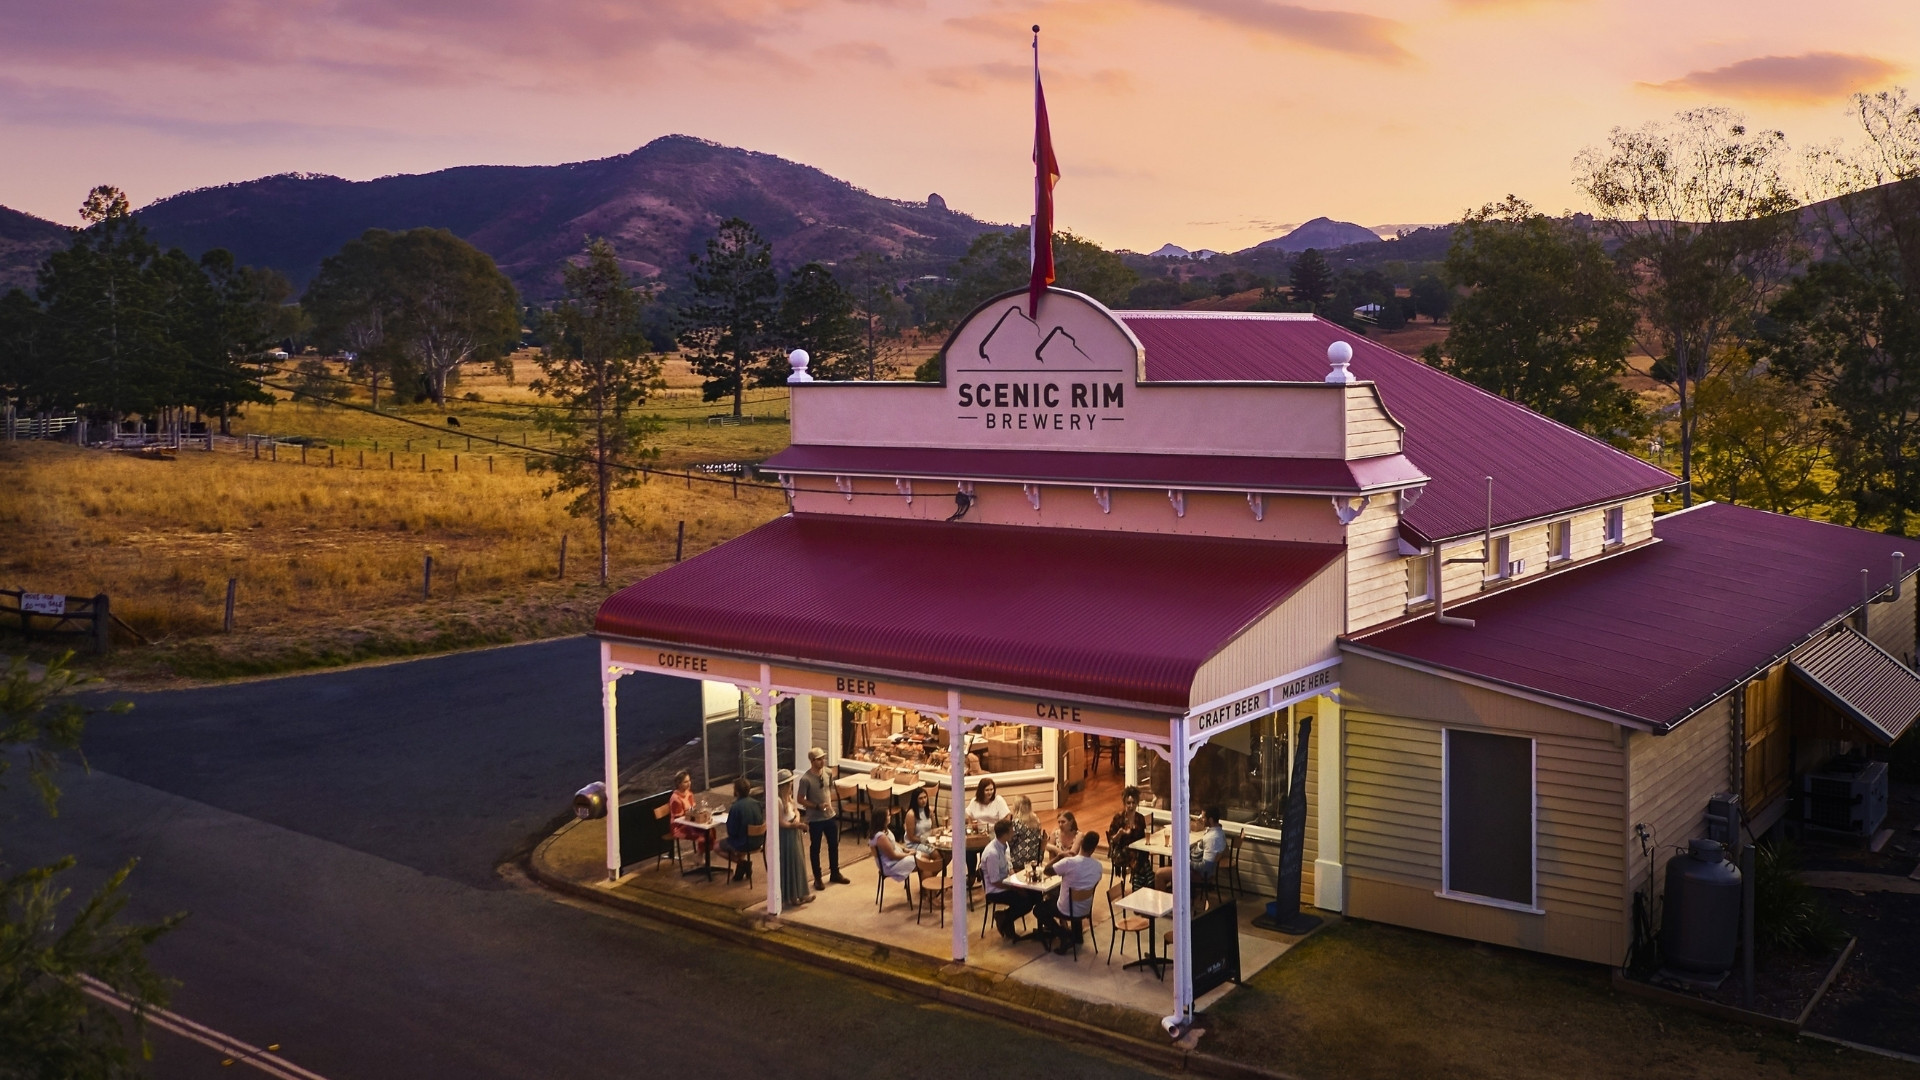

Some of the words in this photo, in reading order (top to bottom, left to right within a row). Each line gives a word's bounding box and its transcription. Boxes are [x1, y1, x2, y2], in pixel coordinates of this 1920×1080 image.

[958, 383, 1060, 408] SCENIC
[1071, 383, 1124, 408] RIM
[986, 413, 1097, 430] BREWERY
[658, 652, 708, 672] COFFEE
[836, 677, 876, 696] BEER
[1282, 679, 1306, 699] MADE
[1308, 670, 1330, 690] HERE
[1036, 702, 1082, 722] CAFE
[1198, 705, 1232, 730] CRAFT
[1234, 695, 1260, 717] BEER
